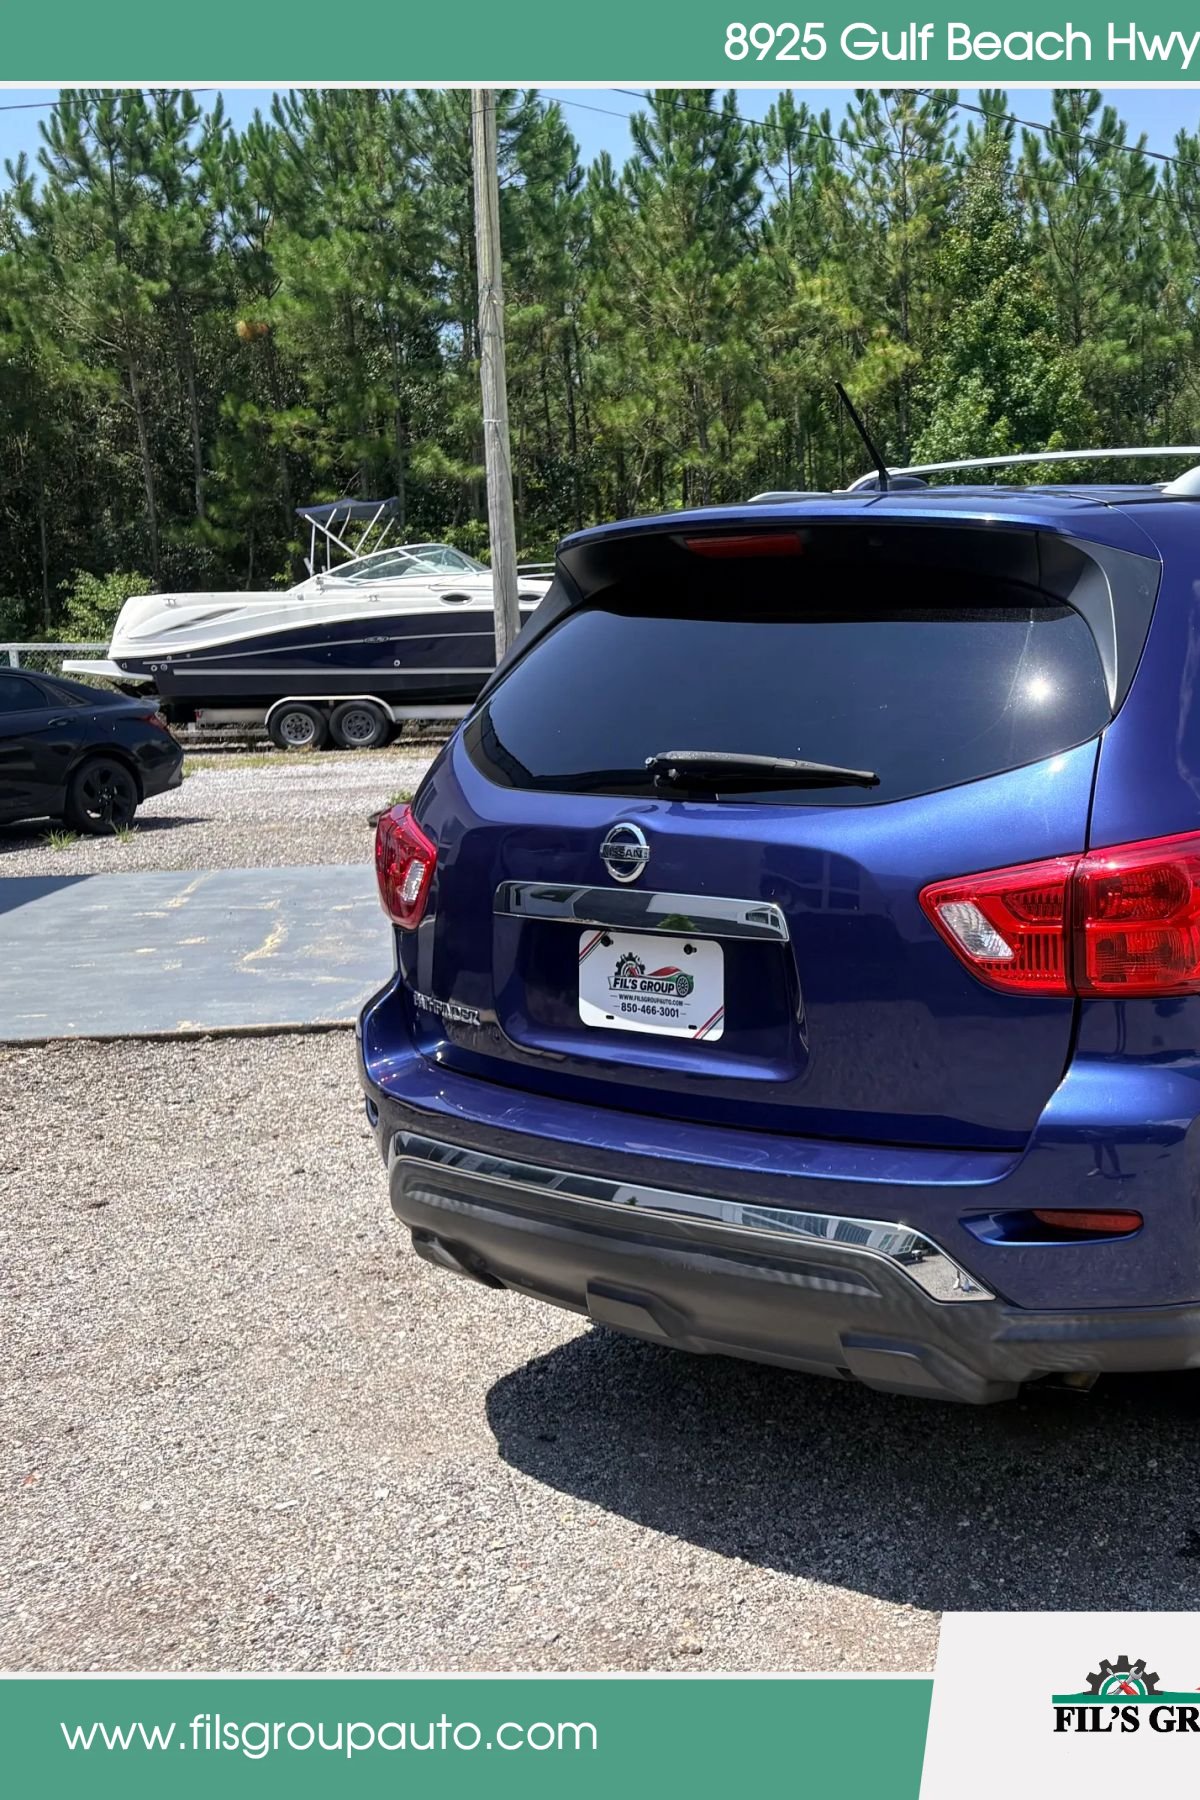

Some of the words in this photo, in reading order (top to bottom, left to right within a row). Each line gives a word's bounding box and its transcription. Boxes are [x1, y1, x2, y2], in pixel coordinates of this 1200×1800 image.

[602, 843, 644, 859] NISSAN
[612, 976, 638, 991] FIL'S
[639, 979, 675, 994] GROUP
[620, 1002, 680, 1018] 850-466-3001
